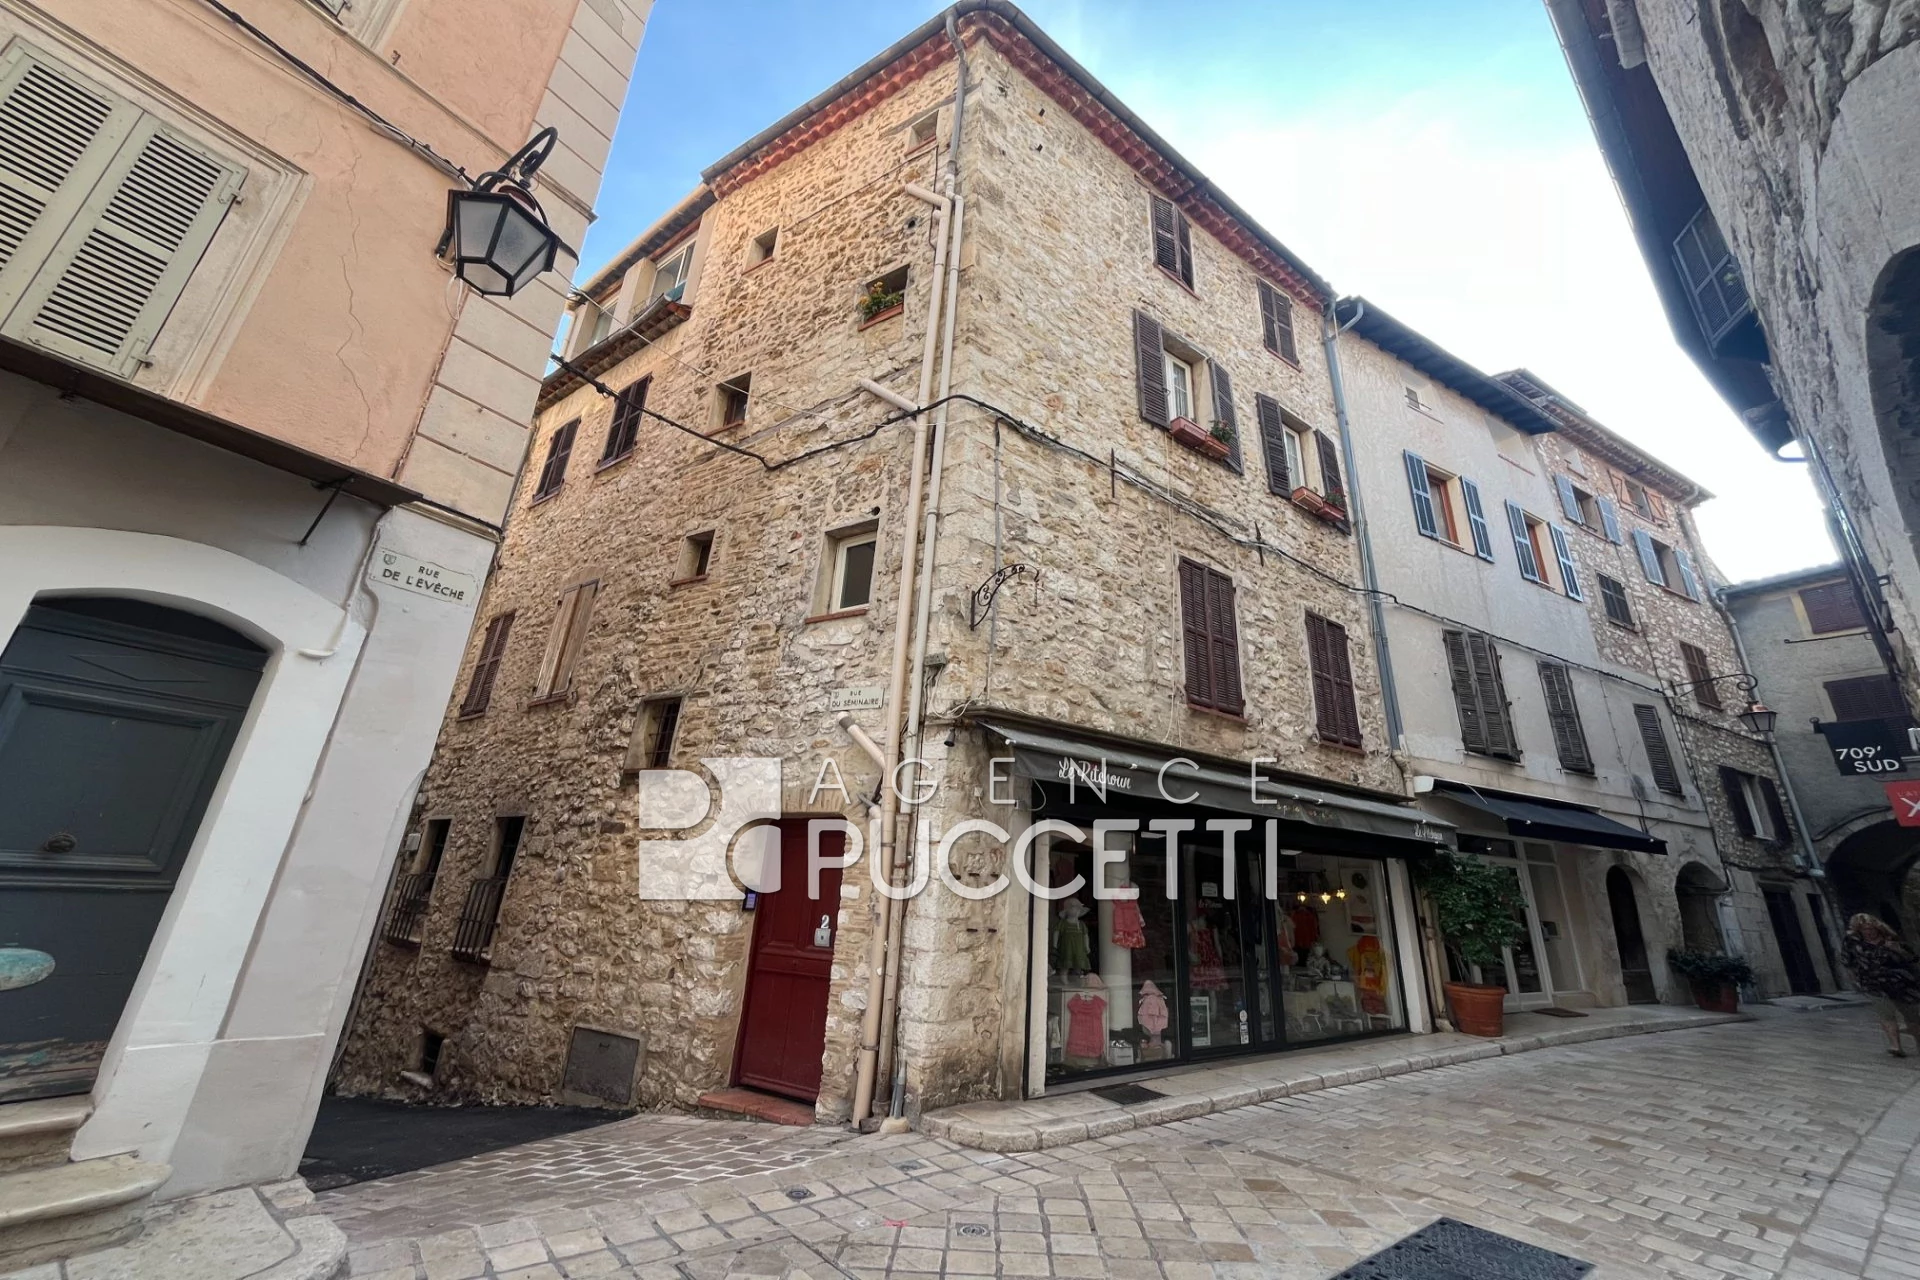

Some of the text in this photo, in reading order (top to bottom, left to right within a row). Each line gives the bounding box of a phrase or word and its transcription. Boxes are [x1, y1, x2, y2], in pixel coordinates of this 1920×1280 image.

[382, 568, 401, 582] DE
[418, 565, 440, 579] RUE
[1058, 756, 1131, 789] Le Pitchoun
[1854, 759, 1900, 773] SUD
[820, 914, 830, 929] 2
